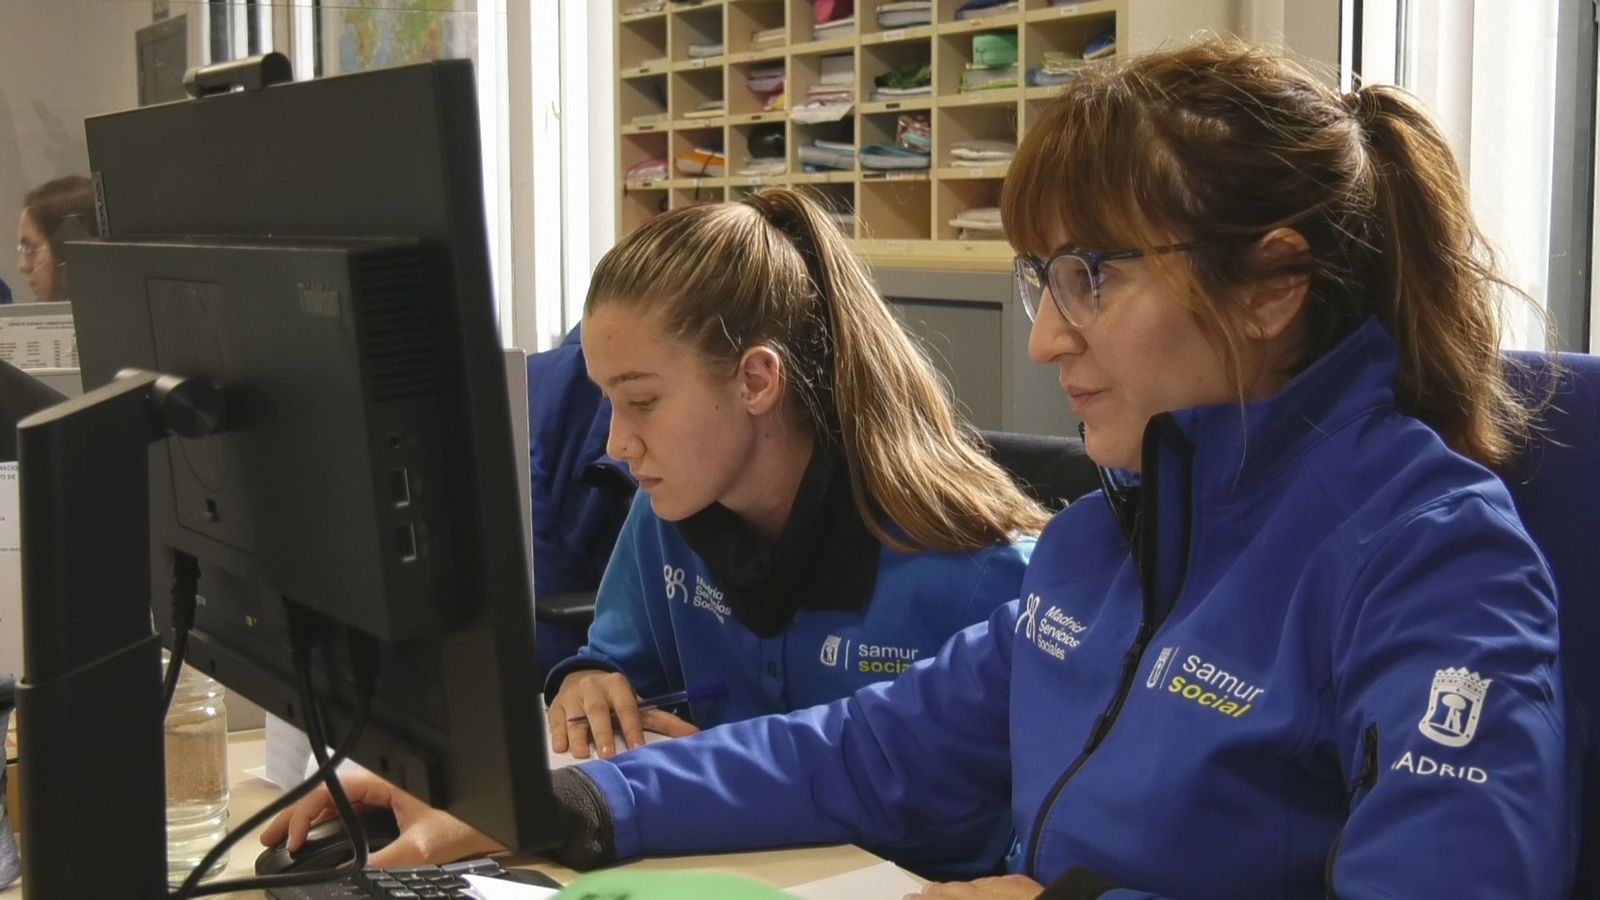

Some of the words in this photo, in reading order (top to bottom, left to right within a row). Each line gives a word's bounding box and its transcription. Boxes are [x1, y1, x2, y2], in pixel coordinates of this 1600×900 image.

[1039, 618, 1080, 647] Servicios
[1044, 605, 1087, 633] Madrid
[858, 643, 919, 660] samur
[1037, 633, 1065, 660] Sociales
[1182, 654, 1265, 702] samur
[1167, 676, 1251, 718] social
[1391, 751, 1488, 783] ADRID
